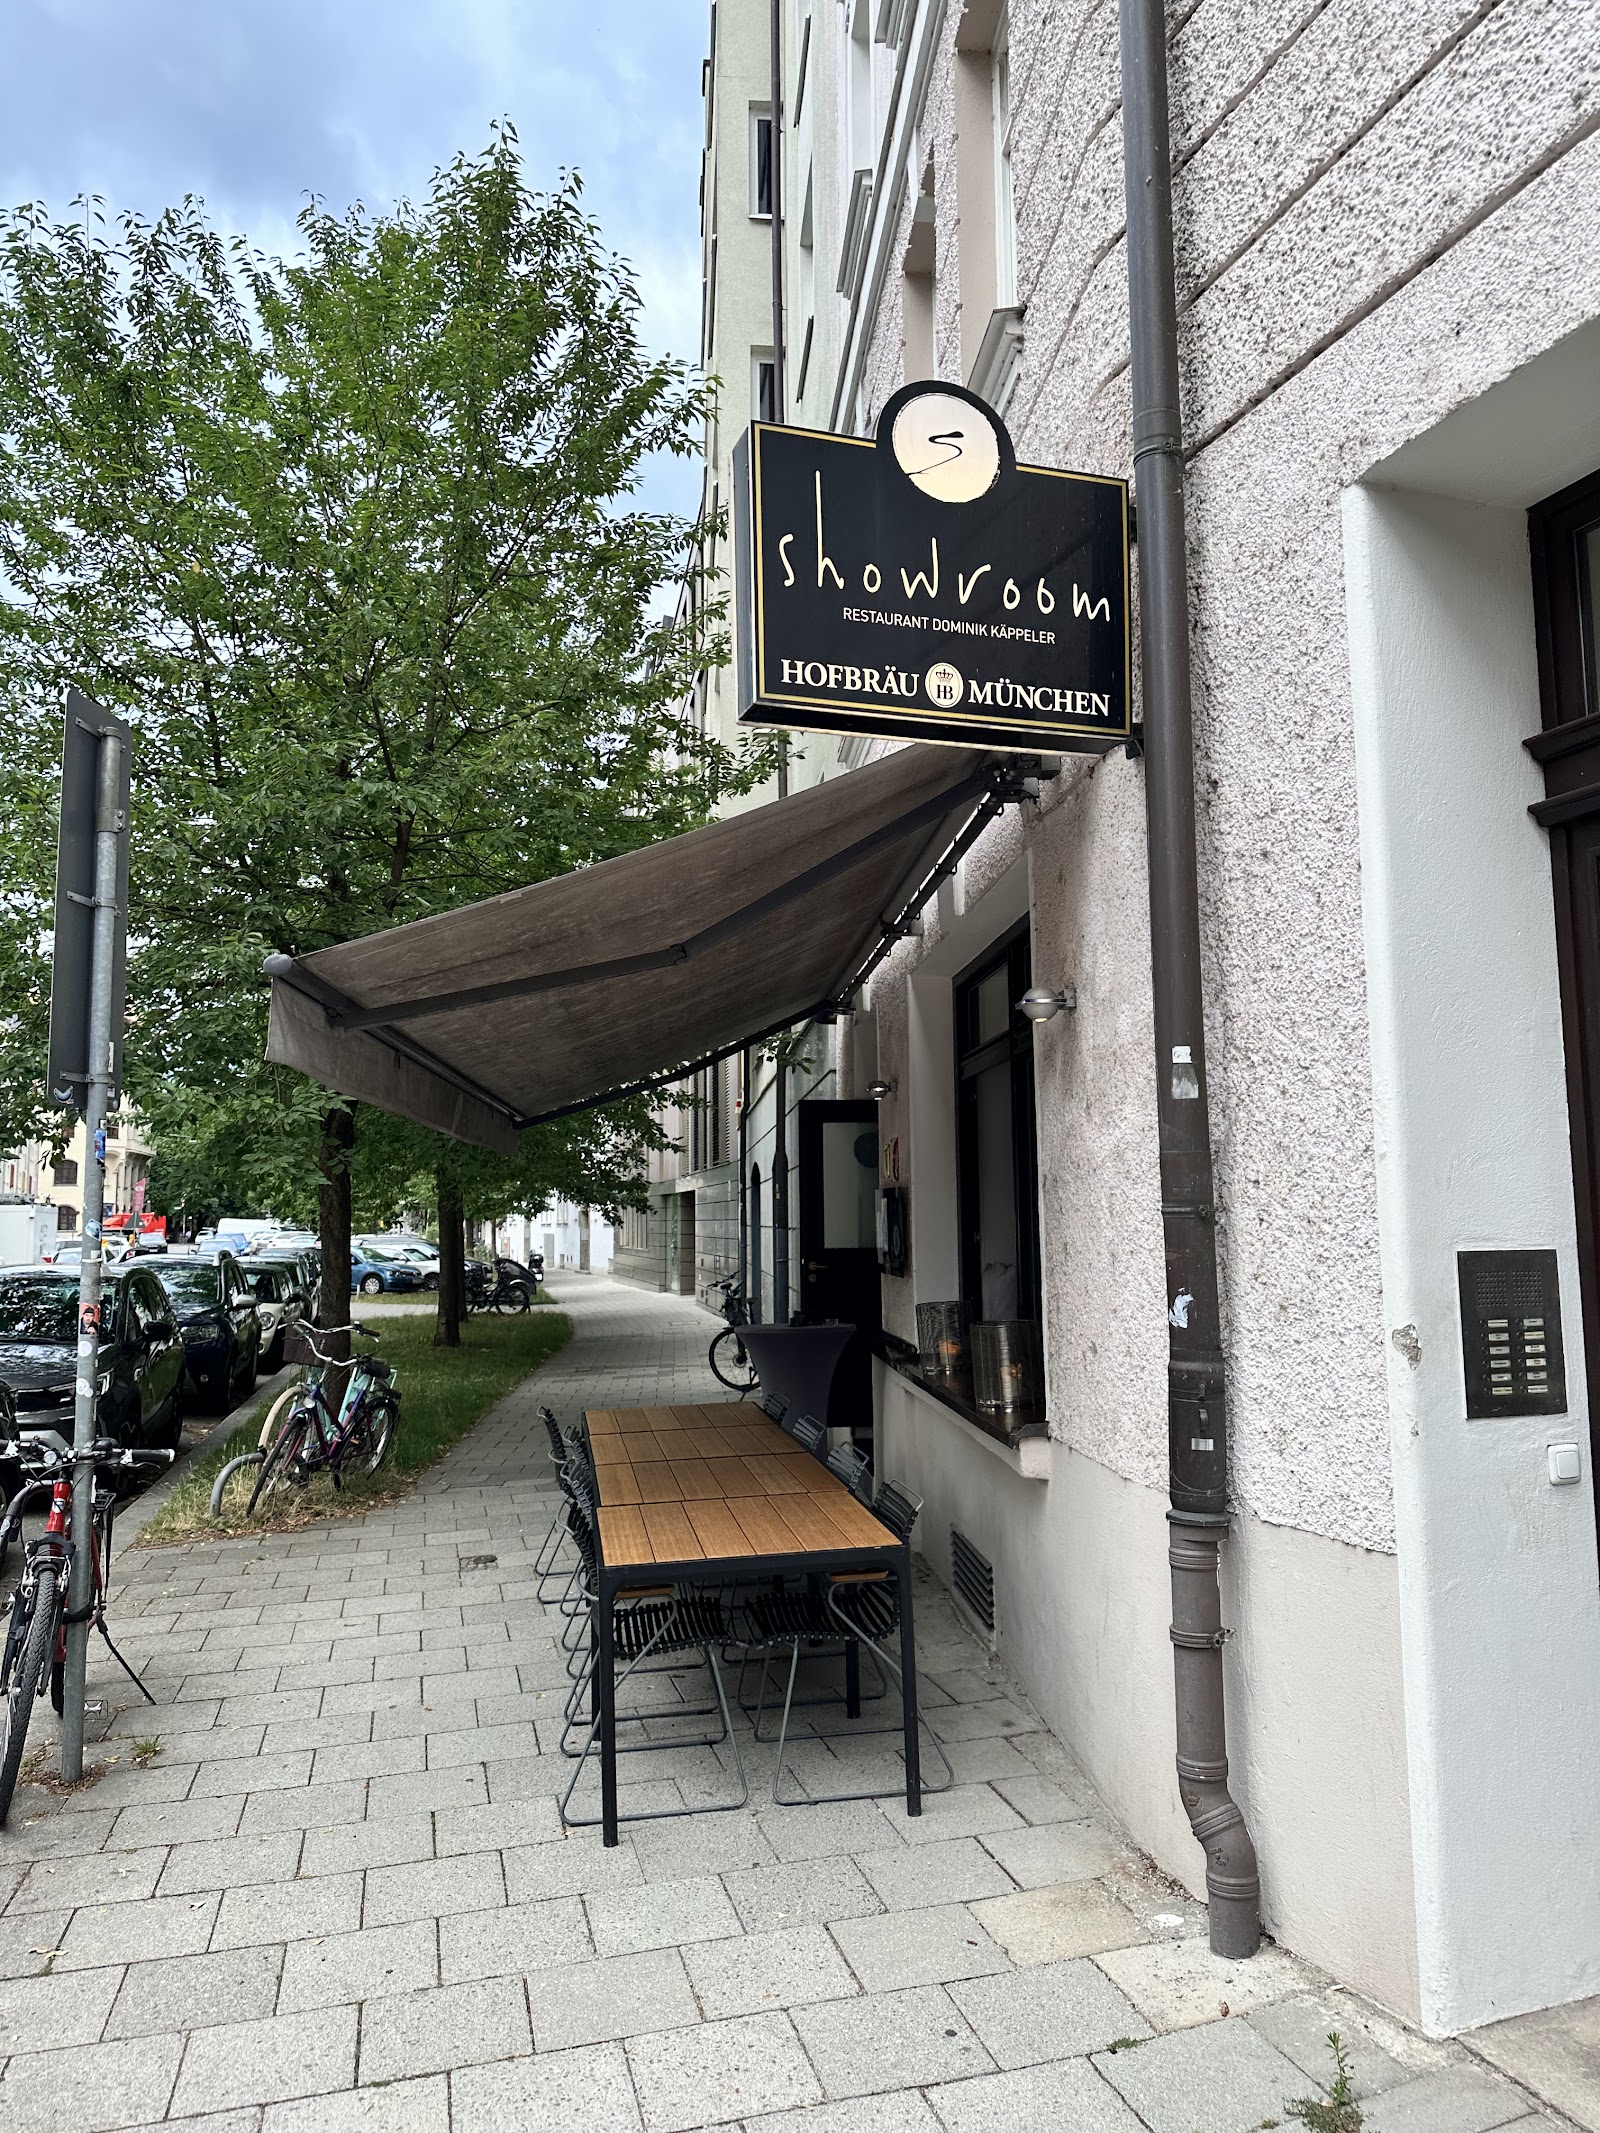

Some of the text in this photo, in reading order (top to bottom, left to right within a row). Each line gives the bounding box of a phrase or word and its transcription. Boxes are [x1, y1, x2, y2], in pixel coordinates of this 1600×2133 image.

[779, 470, 1111, 622] showroom
[843, 607, 1056, 645] RESTAURANT DOMINIK KÄPPELER
[780, 658, 1110, 717] HOFBRÄU HB MÜNCHEN
